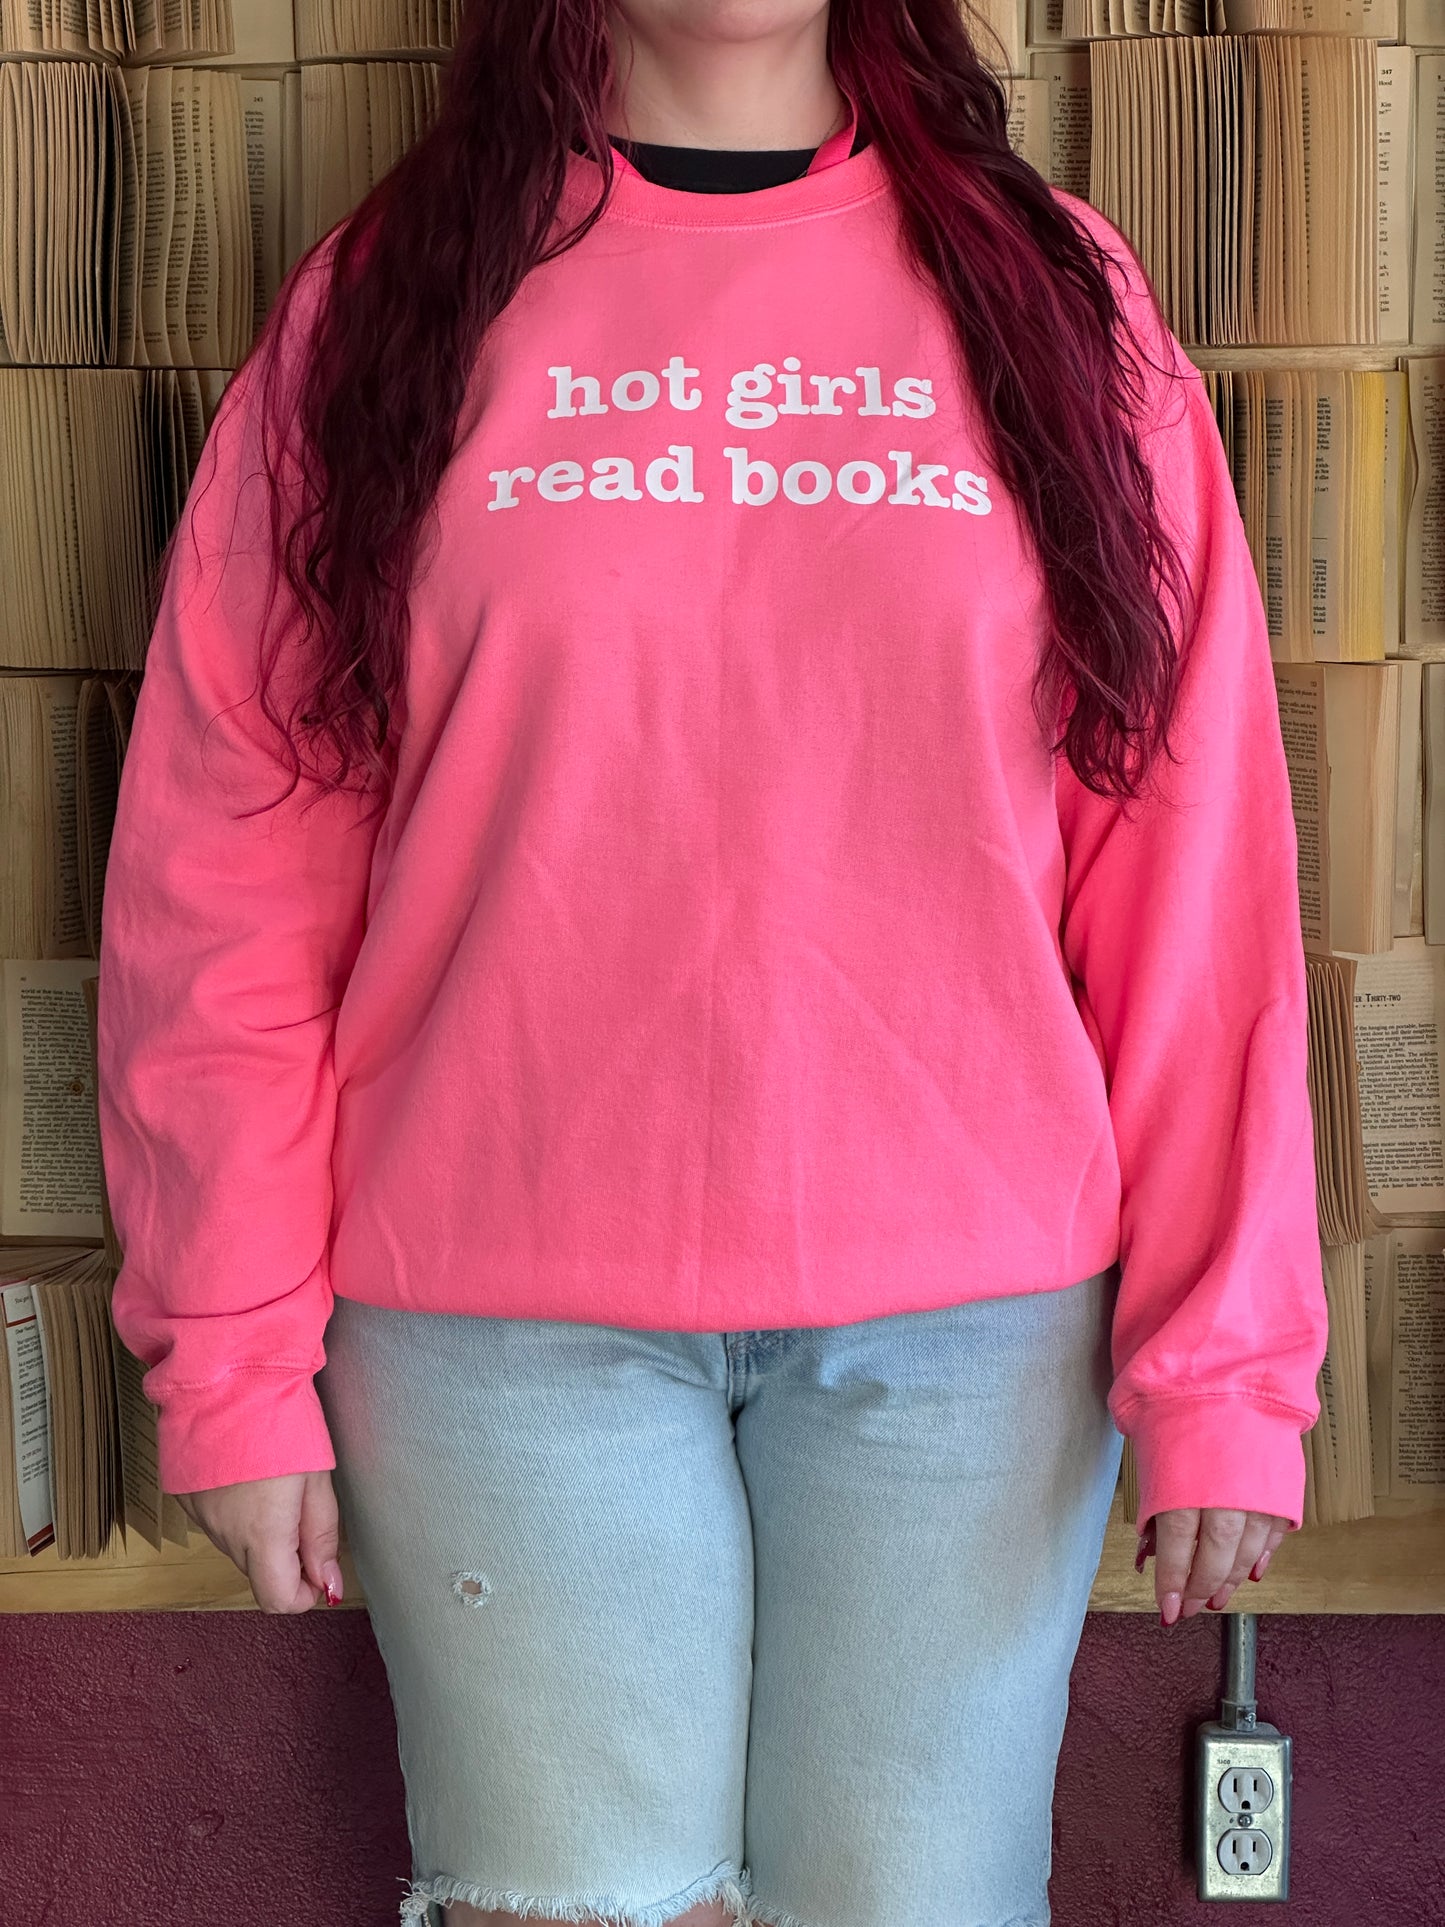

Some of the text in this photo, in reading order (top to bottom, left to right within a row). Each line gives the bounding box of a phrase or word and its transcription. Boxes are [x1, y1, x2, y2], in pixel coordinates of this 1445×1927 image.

[546, 356, 937, 430] hot girls
[487, 445, 993, 516] read books
